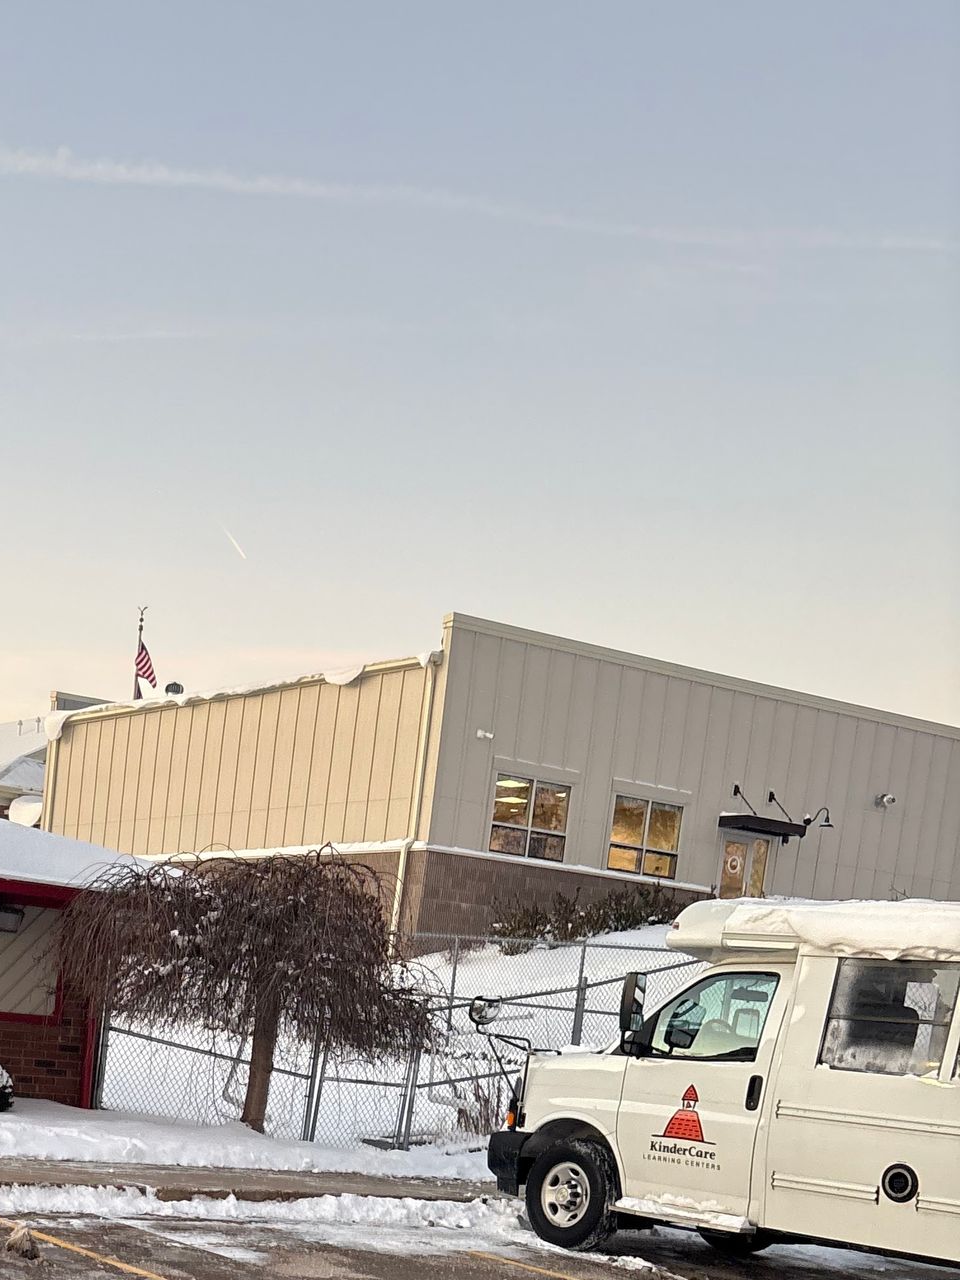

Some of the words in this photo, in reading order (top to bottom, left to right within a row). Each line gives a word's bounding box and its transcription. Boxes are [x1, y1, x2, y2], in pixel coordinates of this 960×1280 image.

[649, 1140, 717, 1160] KinderCare
[642, 1153, 681, 1165] LEARNING
[684, 1160, 721, 1171] CENTERS
